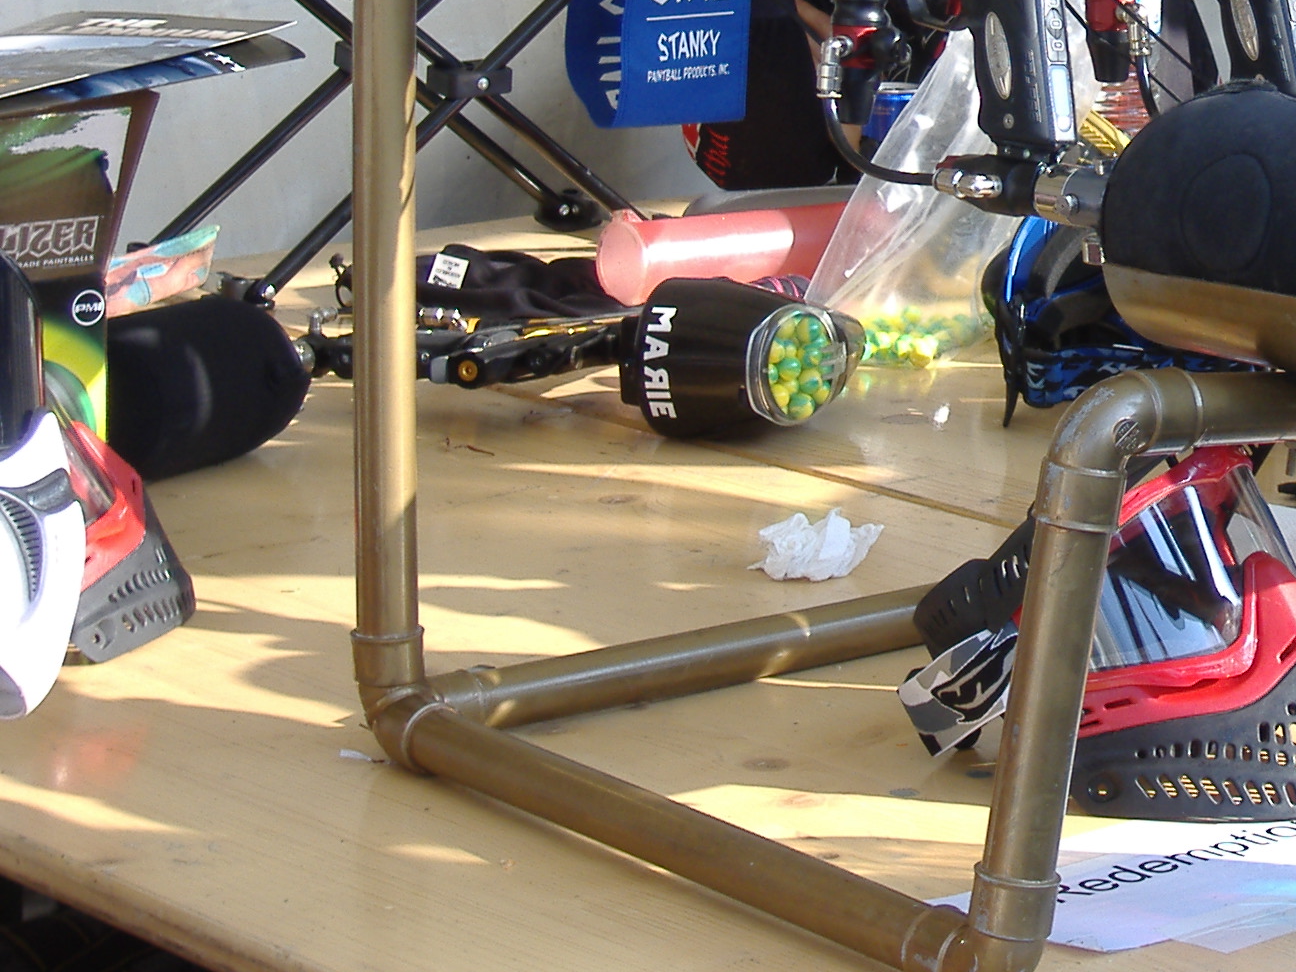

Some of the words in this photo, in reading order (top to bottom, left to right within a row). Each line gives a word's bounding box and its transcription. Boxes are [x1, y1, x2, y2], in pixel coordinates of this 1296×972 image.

[657, 29, 721, 62] STANKY
[647, 68, 682, 83] PAINTBALL
[43, 254, 94, 266] PAINTBALLS
[74, 302, 104, 313] PMI
